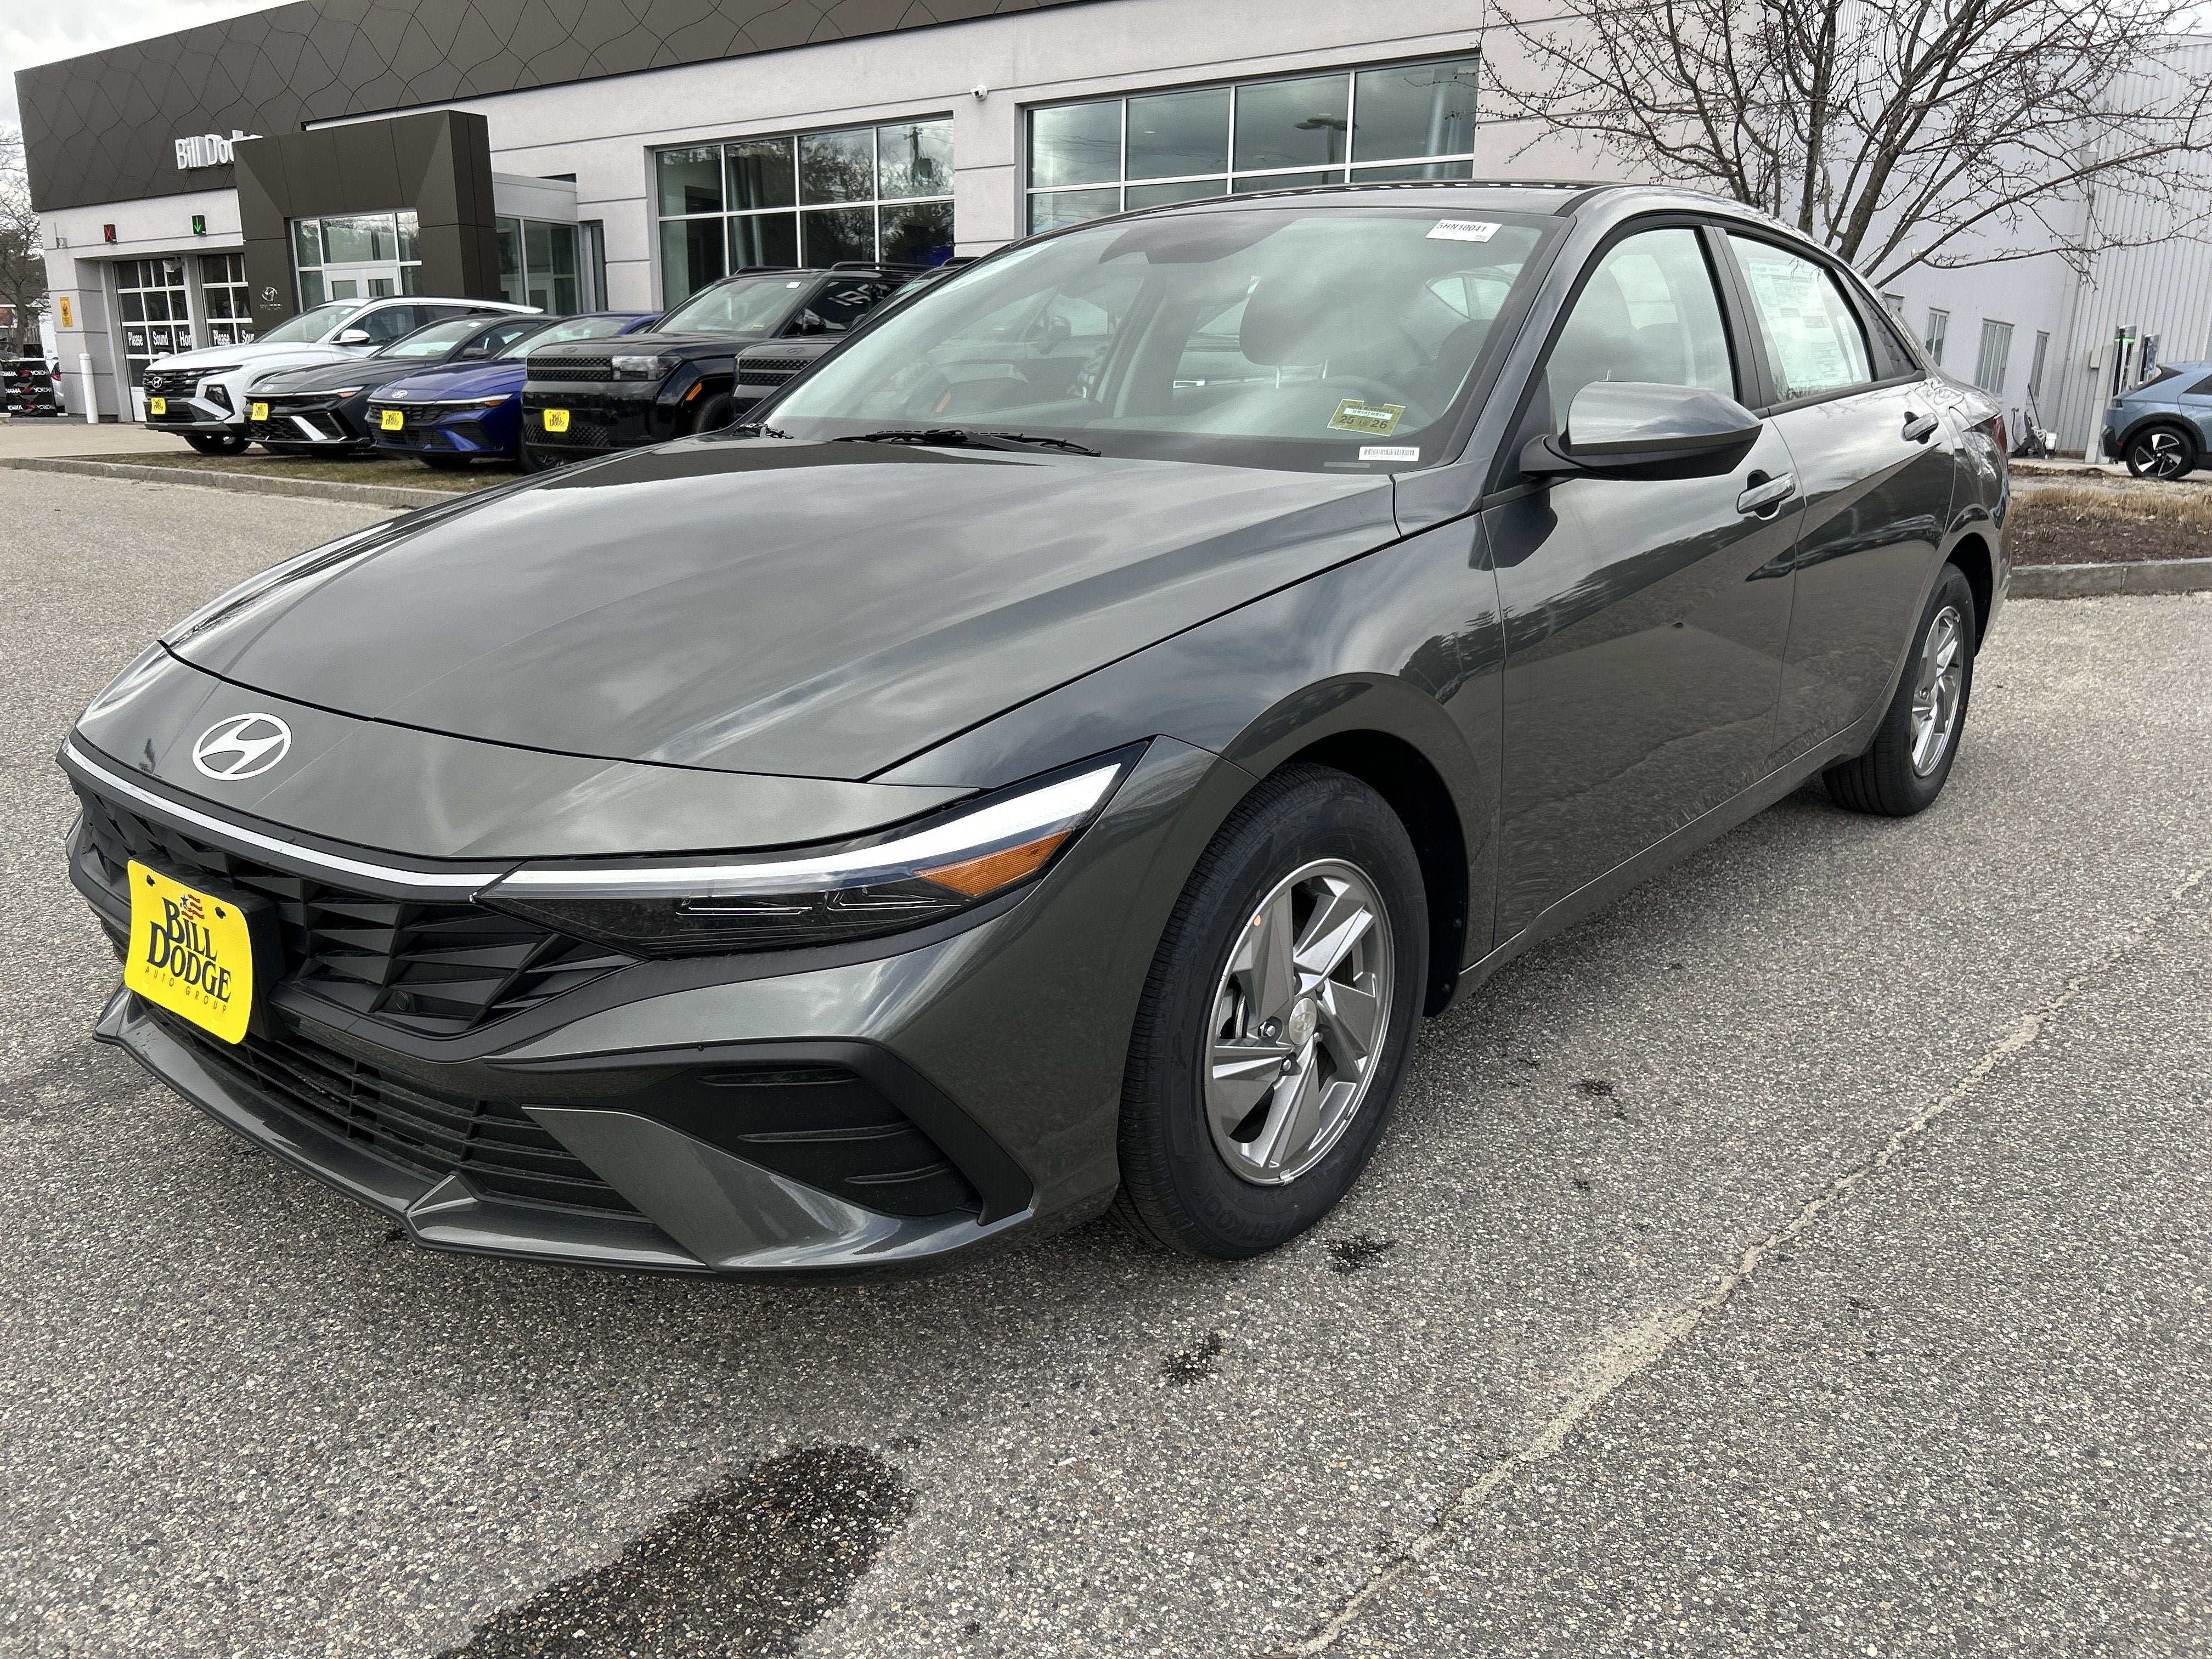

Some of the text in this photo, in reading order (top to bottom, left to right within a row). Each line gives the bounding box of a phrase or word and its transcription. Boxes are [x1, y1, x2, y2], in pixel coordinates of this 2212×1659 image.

[175, 136, 207, 170] Bill
[1437, 223, 1487, 232] 5HN10041
[128, 331, 192, 346] Please Sound Hor
[1338, 415, 1355, 425] 25
[1370, 419, 1389, 429] 26
[161, 896, 218, 962] BILL
[146, 921, 232, 1003] DODGE
[145, 966, 227, 1014] AUTO GROUP
